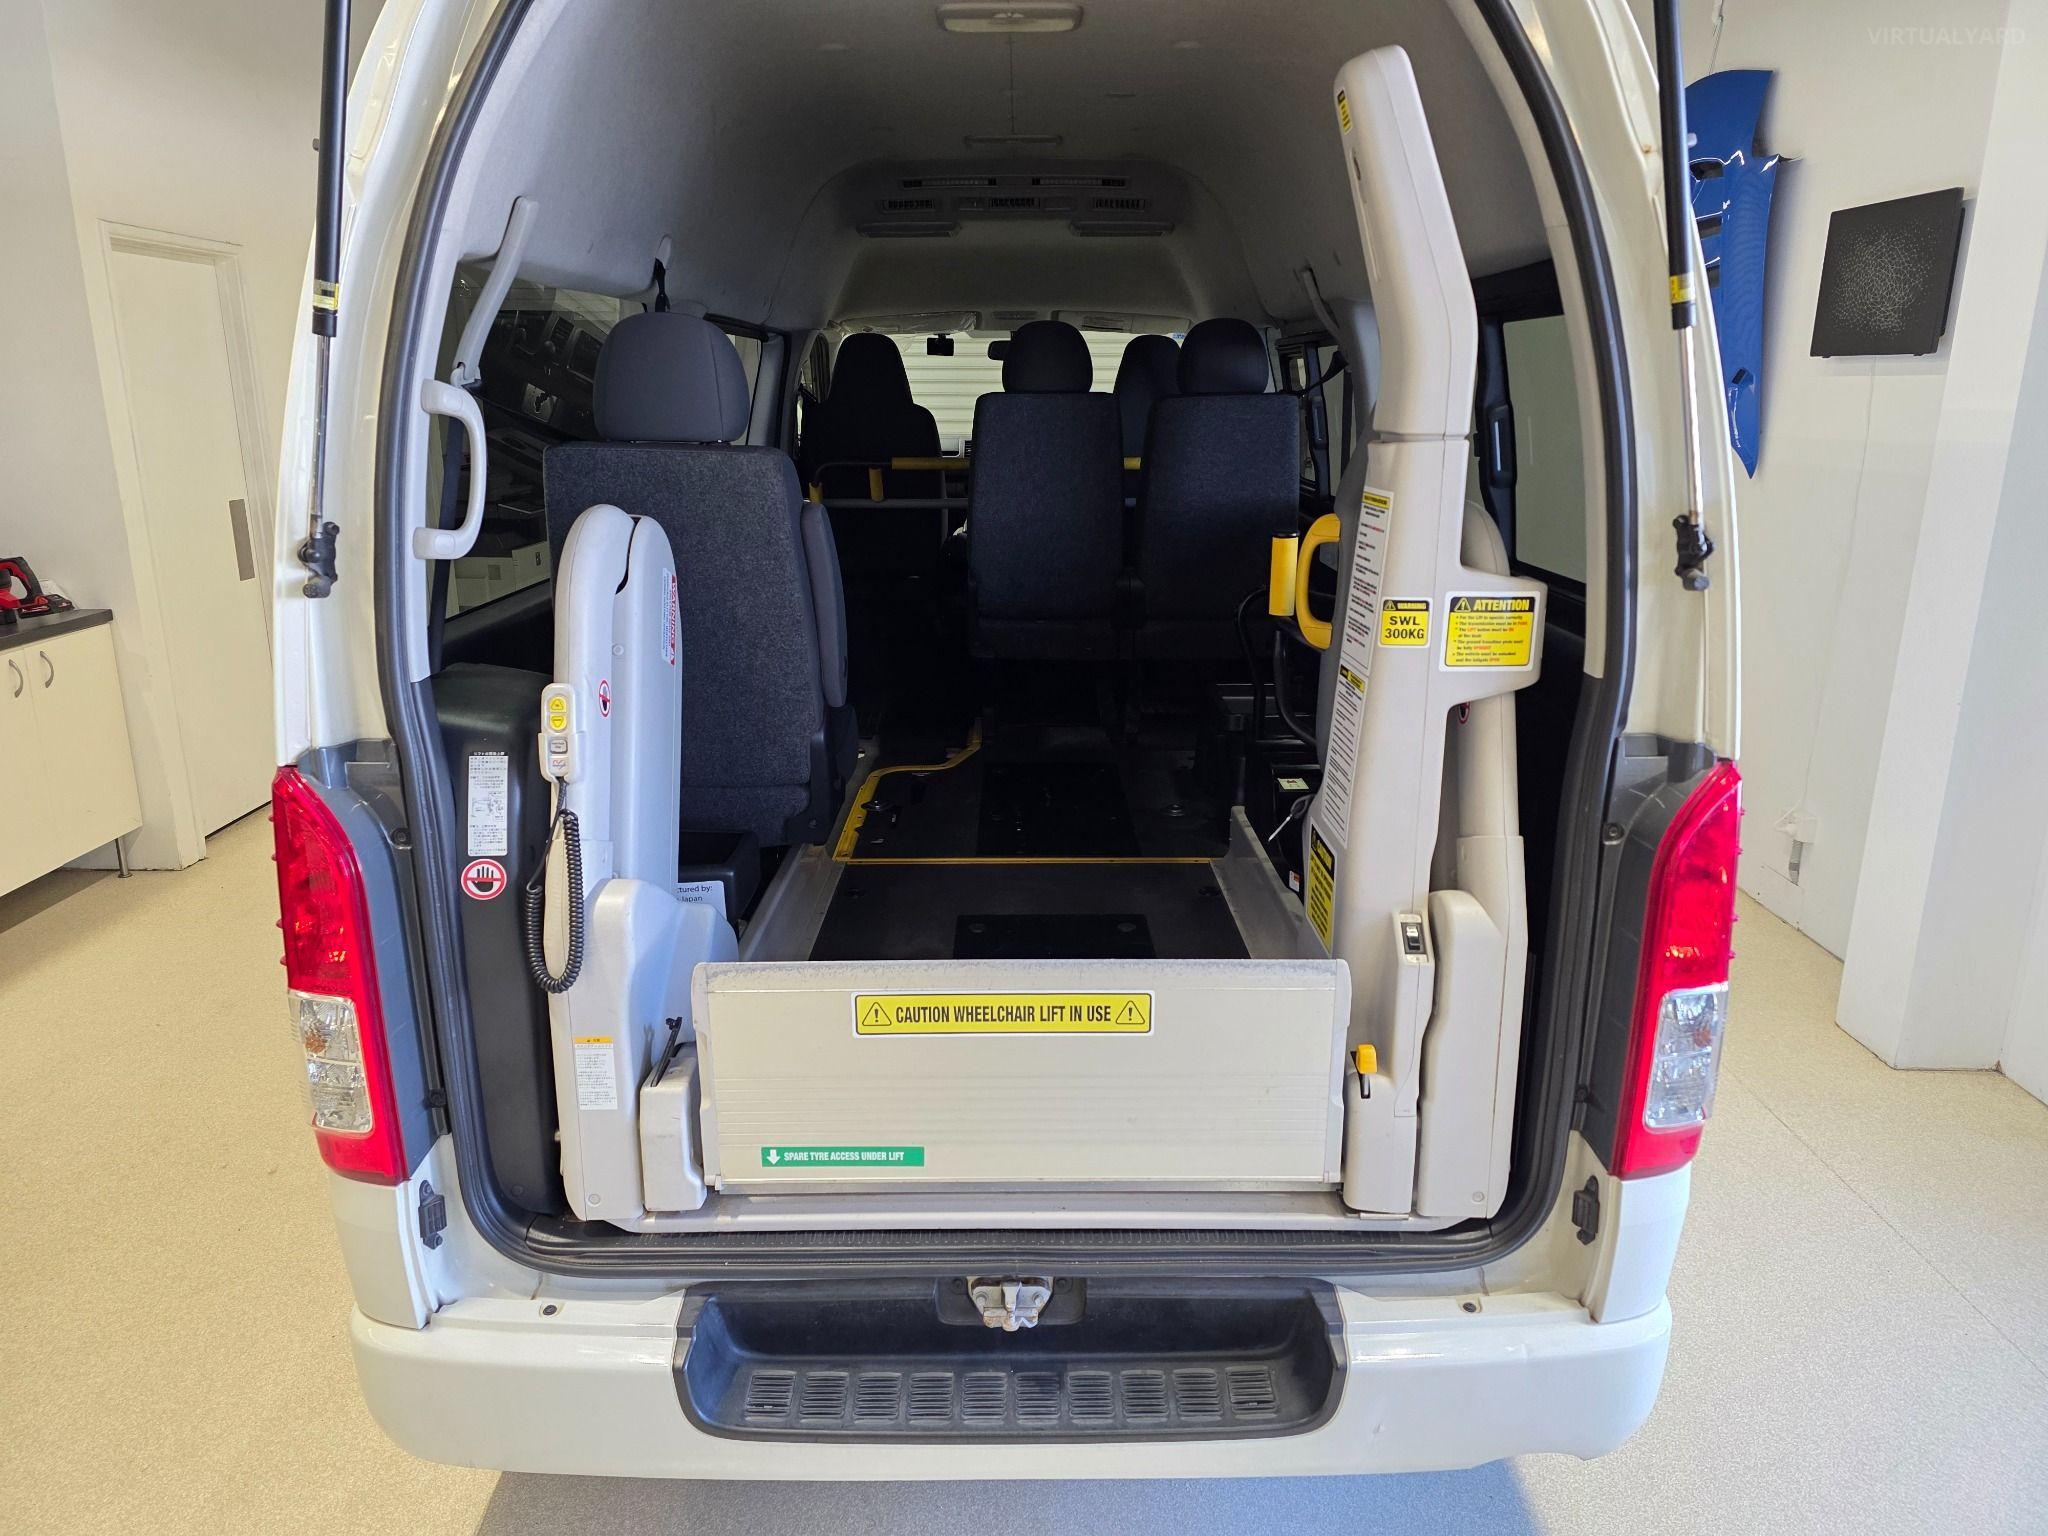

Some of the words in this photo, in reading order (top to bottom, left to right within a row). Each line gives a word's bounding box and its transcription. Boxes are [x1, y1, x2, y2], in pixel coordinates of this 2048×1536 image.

[1473, 599, 1530, 611] ATTENTION
[1389, 615, 1420, 626] SWL
[1385, 628, 1425, 640] 300KG
[701, 885, 713, 894] by:
[895, 1006, 950, 1024] CAUTION
[954, 1005, 1035, 1023] WHEELCHAIR
[1040, 1005, 1066, 1022] LIFT
[1070, 1005, 1083, 1022] IN
[1086, 1004, 1111, 1022] USE
[783, 1151, 809, 1161] SPARE
[809, 1151, 830, 1161] TYRE
[830, 1151, 860, 1161] ACCESS
[861, 1151, 888, 1161] UNDER
[888, 1151, 904, 1161] LIFT
